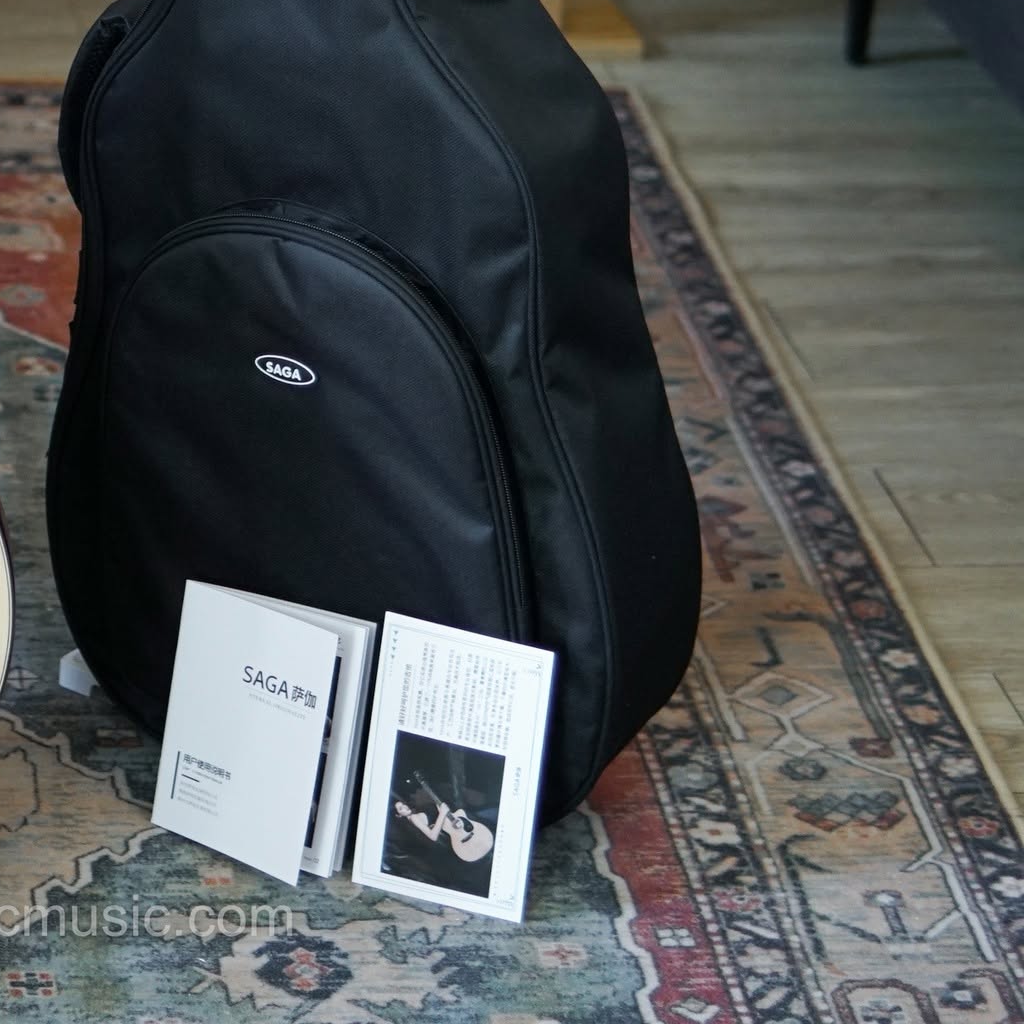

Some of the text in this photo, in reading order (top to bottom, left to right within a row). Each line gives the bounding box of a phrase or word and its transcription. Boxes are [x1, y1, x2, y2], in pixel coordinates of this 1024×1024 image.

[265, 361, 302, 381] SAGA
[242, 665, 289, 699] SAGA
[291, 685, 317, 709] 萨伽
